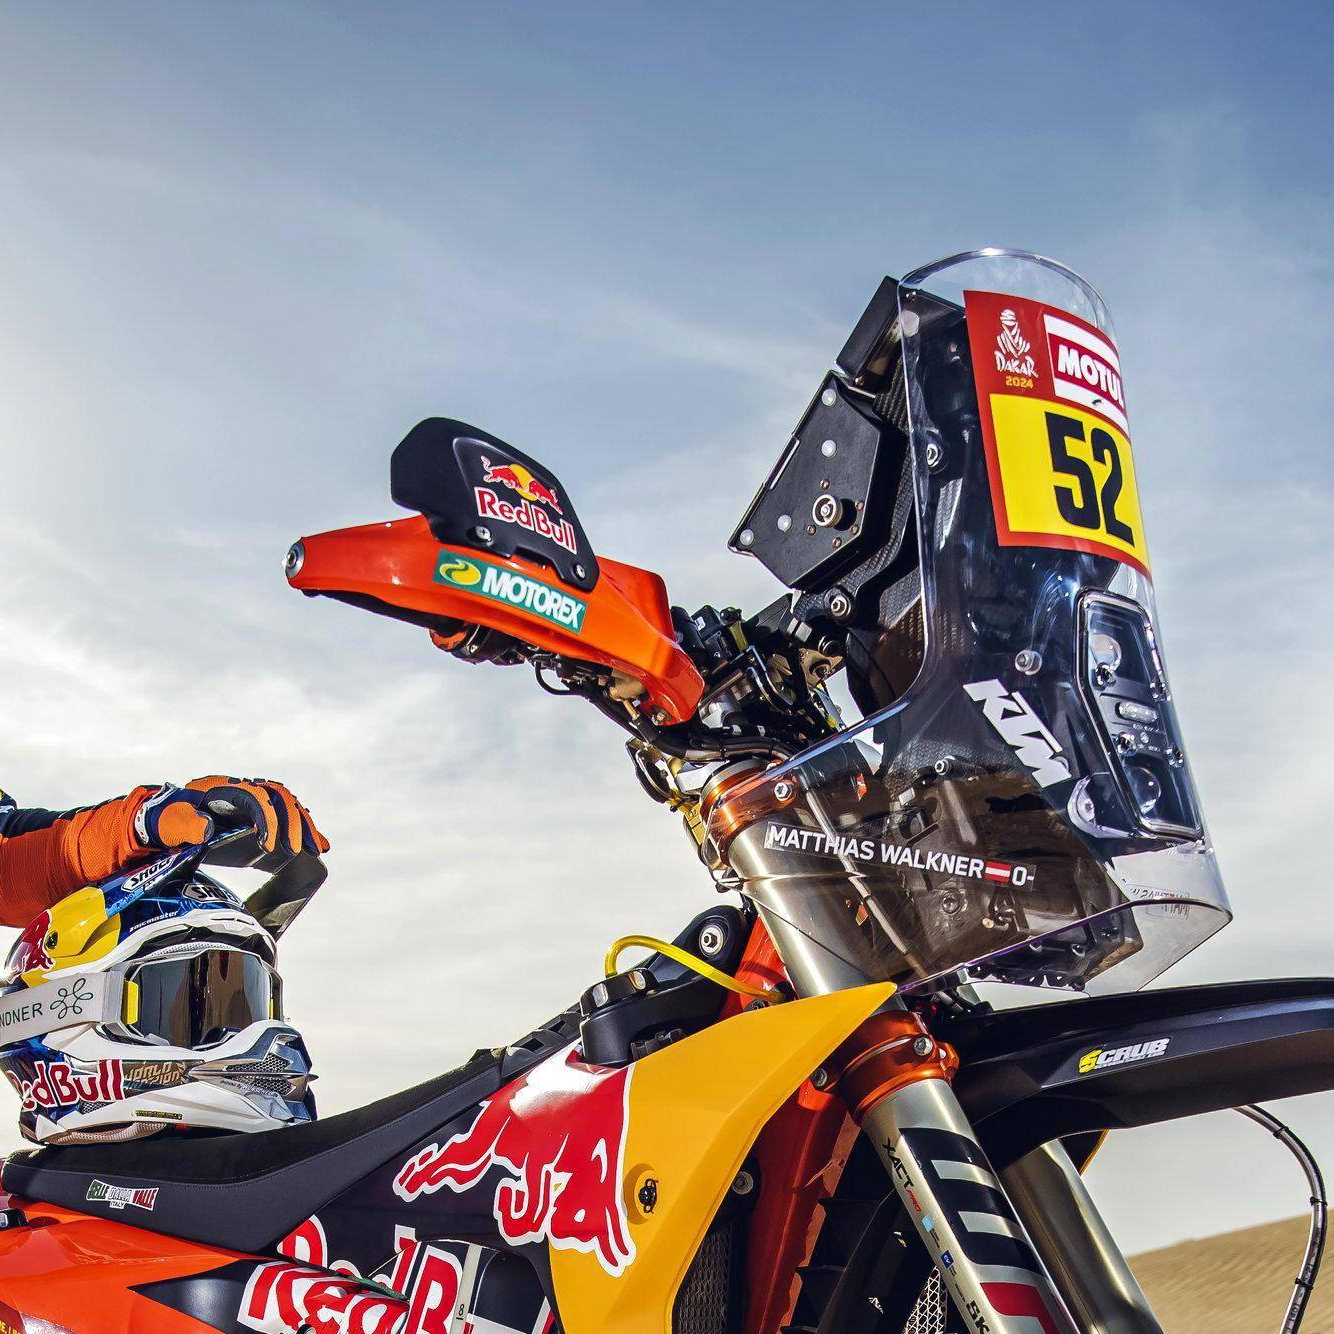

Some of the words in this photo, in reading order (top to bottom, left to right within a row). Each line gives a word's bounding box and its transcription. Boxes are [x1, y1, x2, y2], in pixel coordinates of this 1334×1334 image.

[994, 347, 1039, 379] DAKAR
[1005, 374, 1034, 390] 2024
[1045, 411, 1135, 548] 52
[474, 486, 531, 530] Red
[530, 499, 579, 556] Bull
[481, 566, 586, 630] MOTOREX
[964, 678, 1072, 788] KTM
[766, 824, 875, 860] MATTHIAS
[880, 843, 984, 880] WALKNER
[49, 1059, 126, 1106] Bull
[1079, 1037, 1170, 1074] SCRUB
[882, 1137, 915, 1189] XACT
